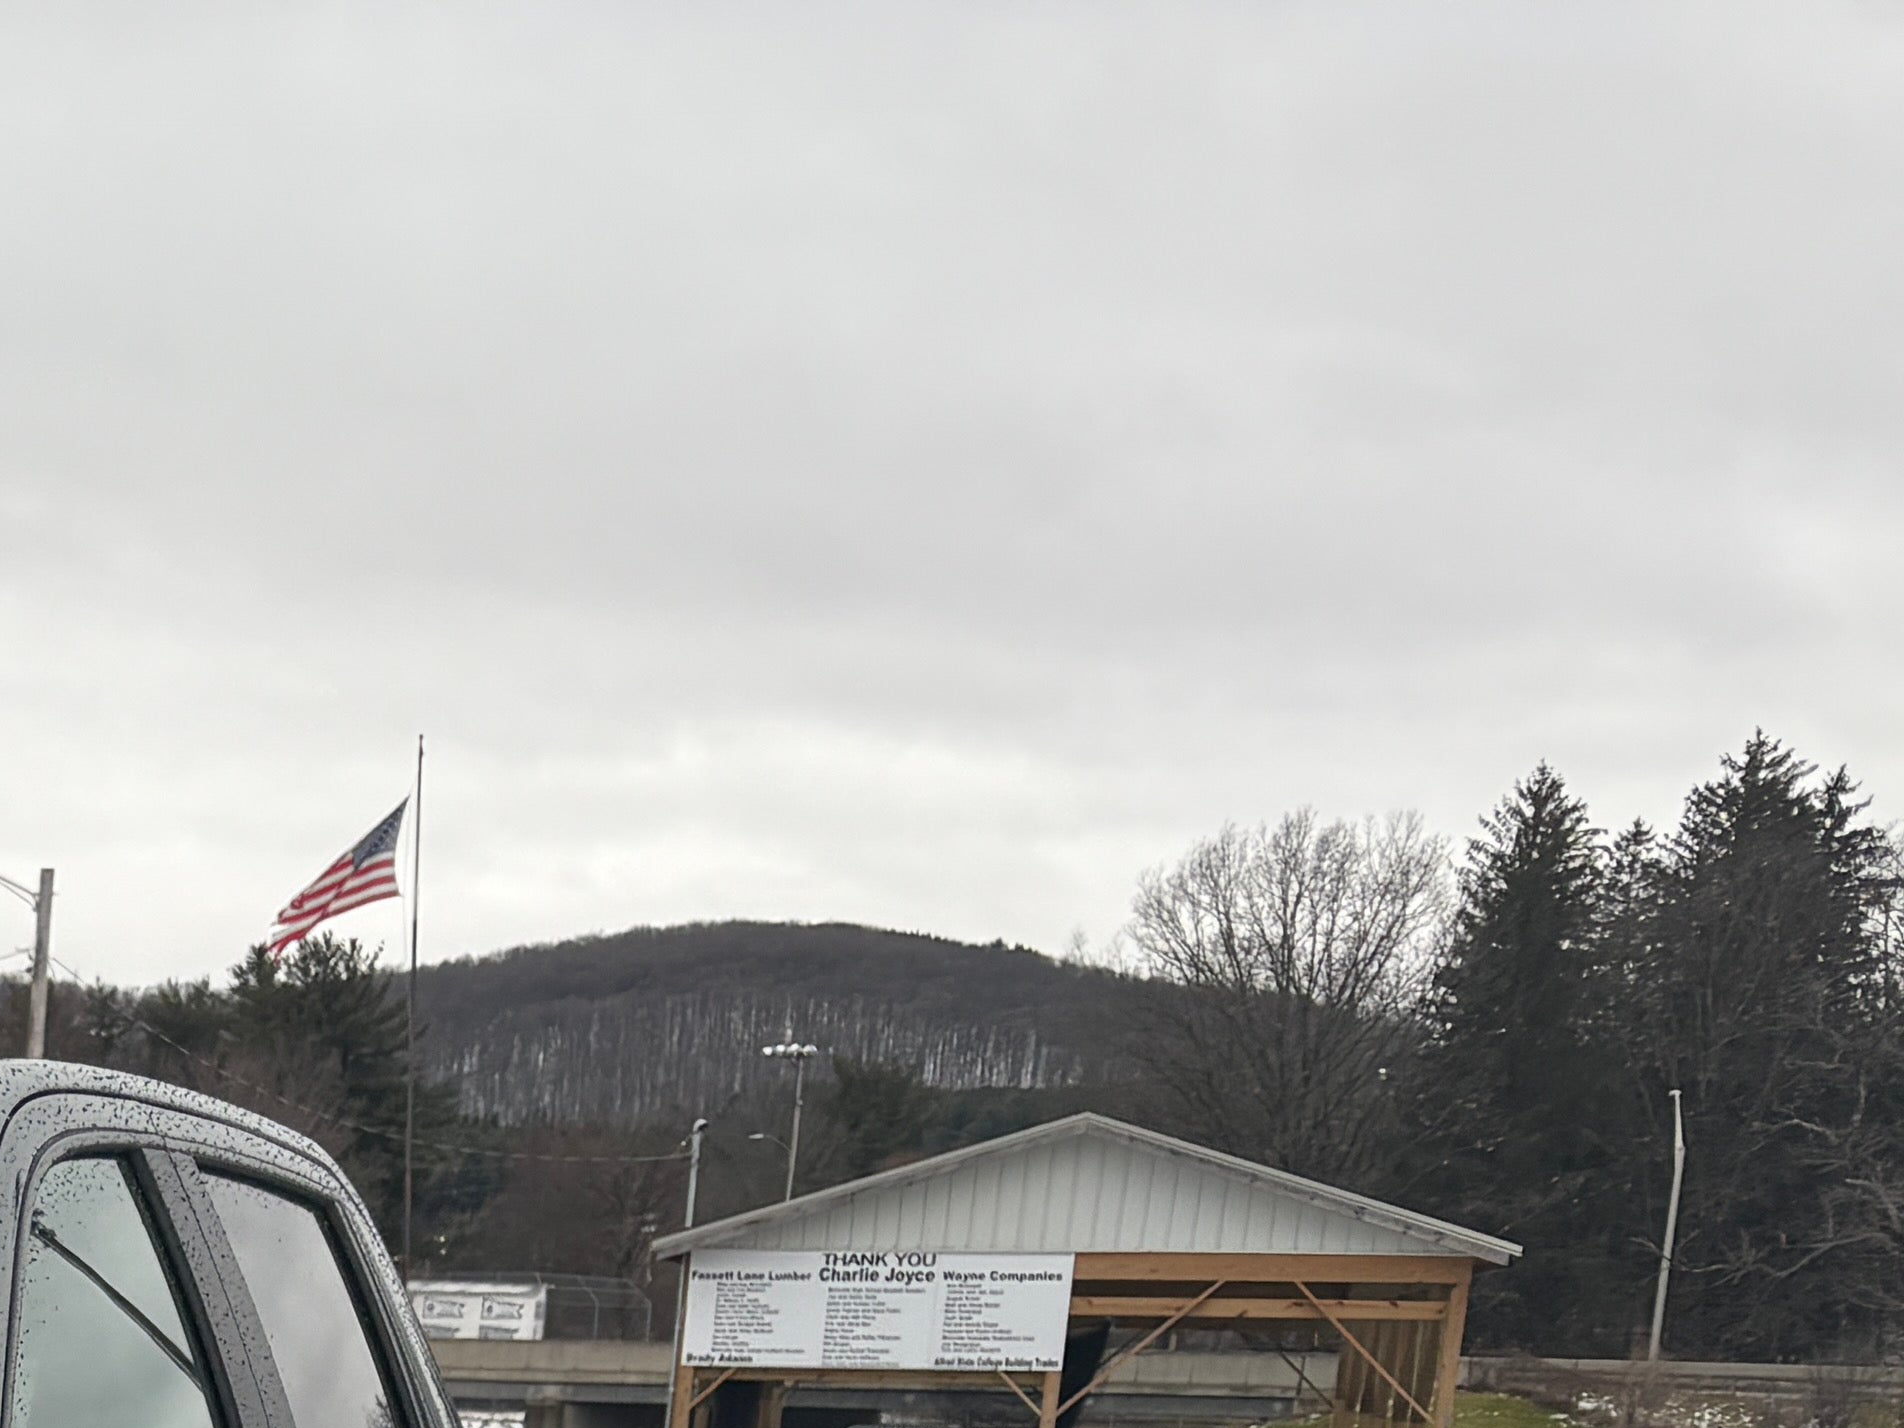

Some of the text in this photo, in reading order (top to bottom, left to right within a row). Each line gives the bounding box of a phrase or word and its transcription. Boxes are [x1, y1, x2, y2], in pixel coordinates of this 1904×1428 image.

[824, 1252, 937, 1267] THANK YOU
[819, 1267, 935, 1285] Charlie Joyce
[943, 1271, 1063, 1283] Wayne Companies
